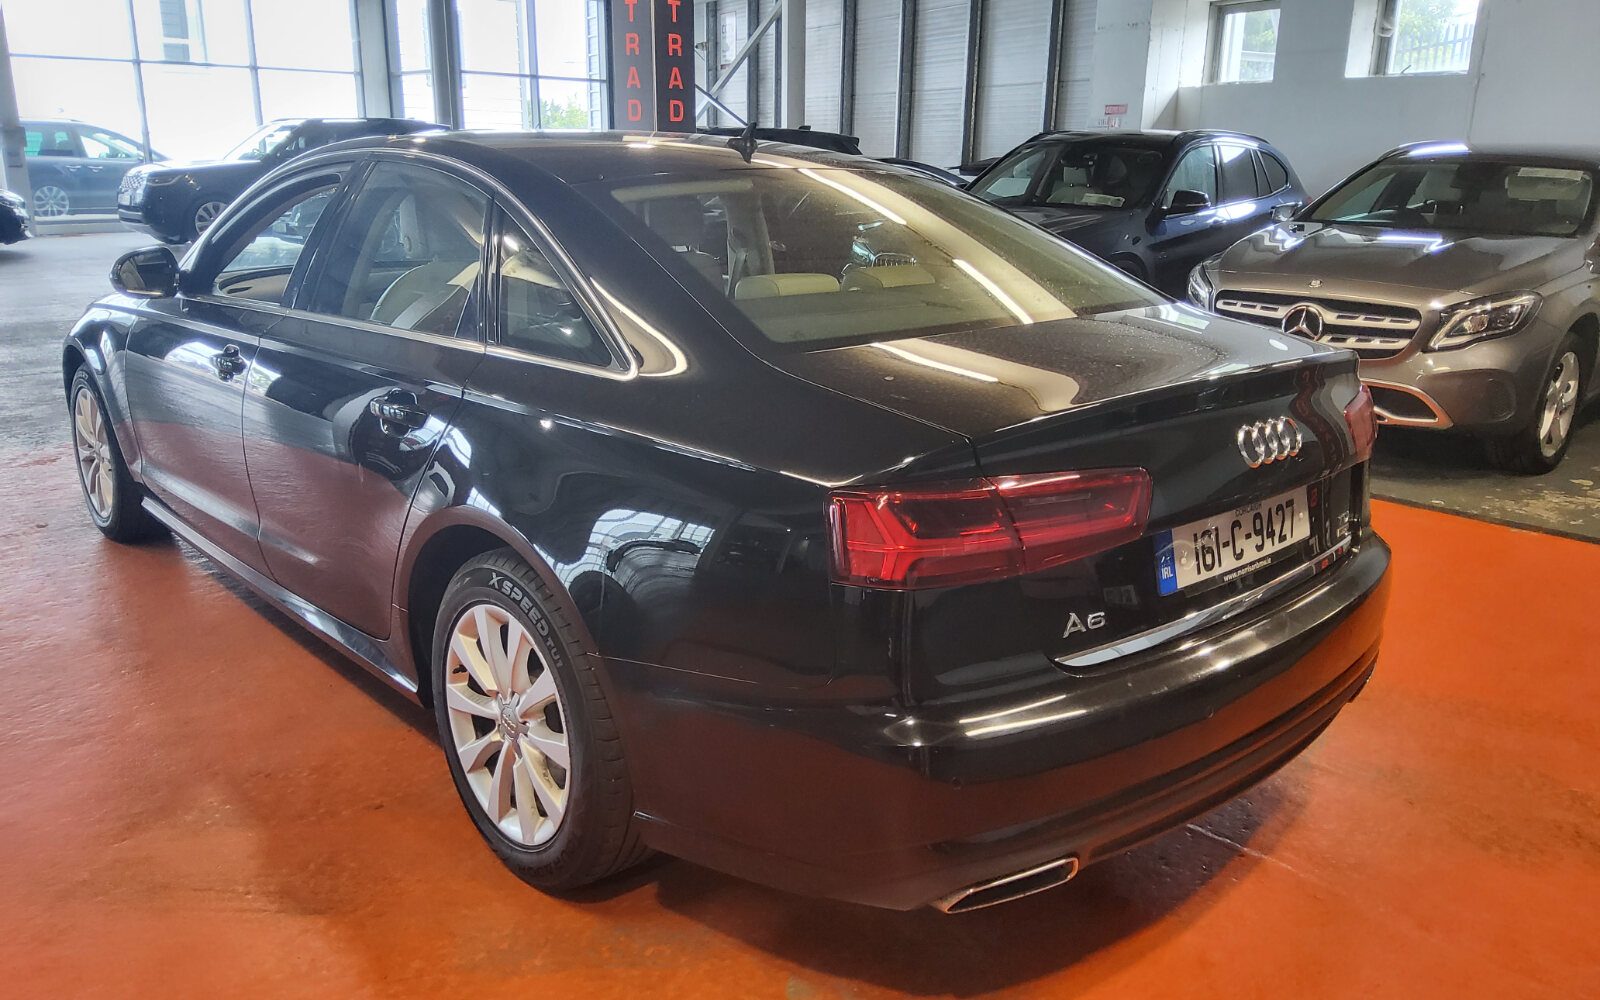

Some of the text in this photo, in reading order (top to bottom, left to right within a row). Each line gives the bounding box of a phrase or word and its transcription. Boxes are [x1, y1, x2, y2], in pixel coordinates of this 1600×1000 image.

[1193, 499, 1295, 575] 161-C-9427
[1161, 566, 1174, 580] IRL
[1062, 611, 1106, 639] A6
